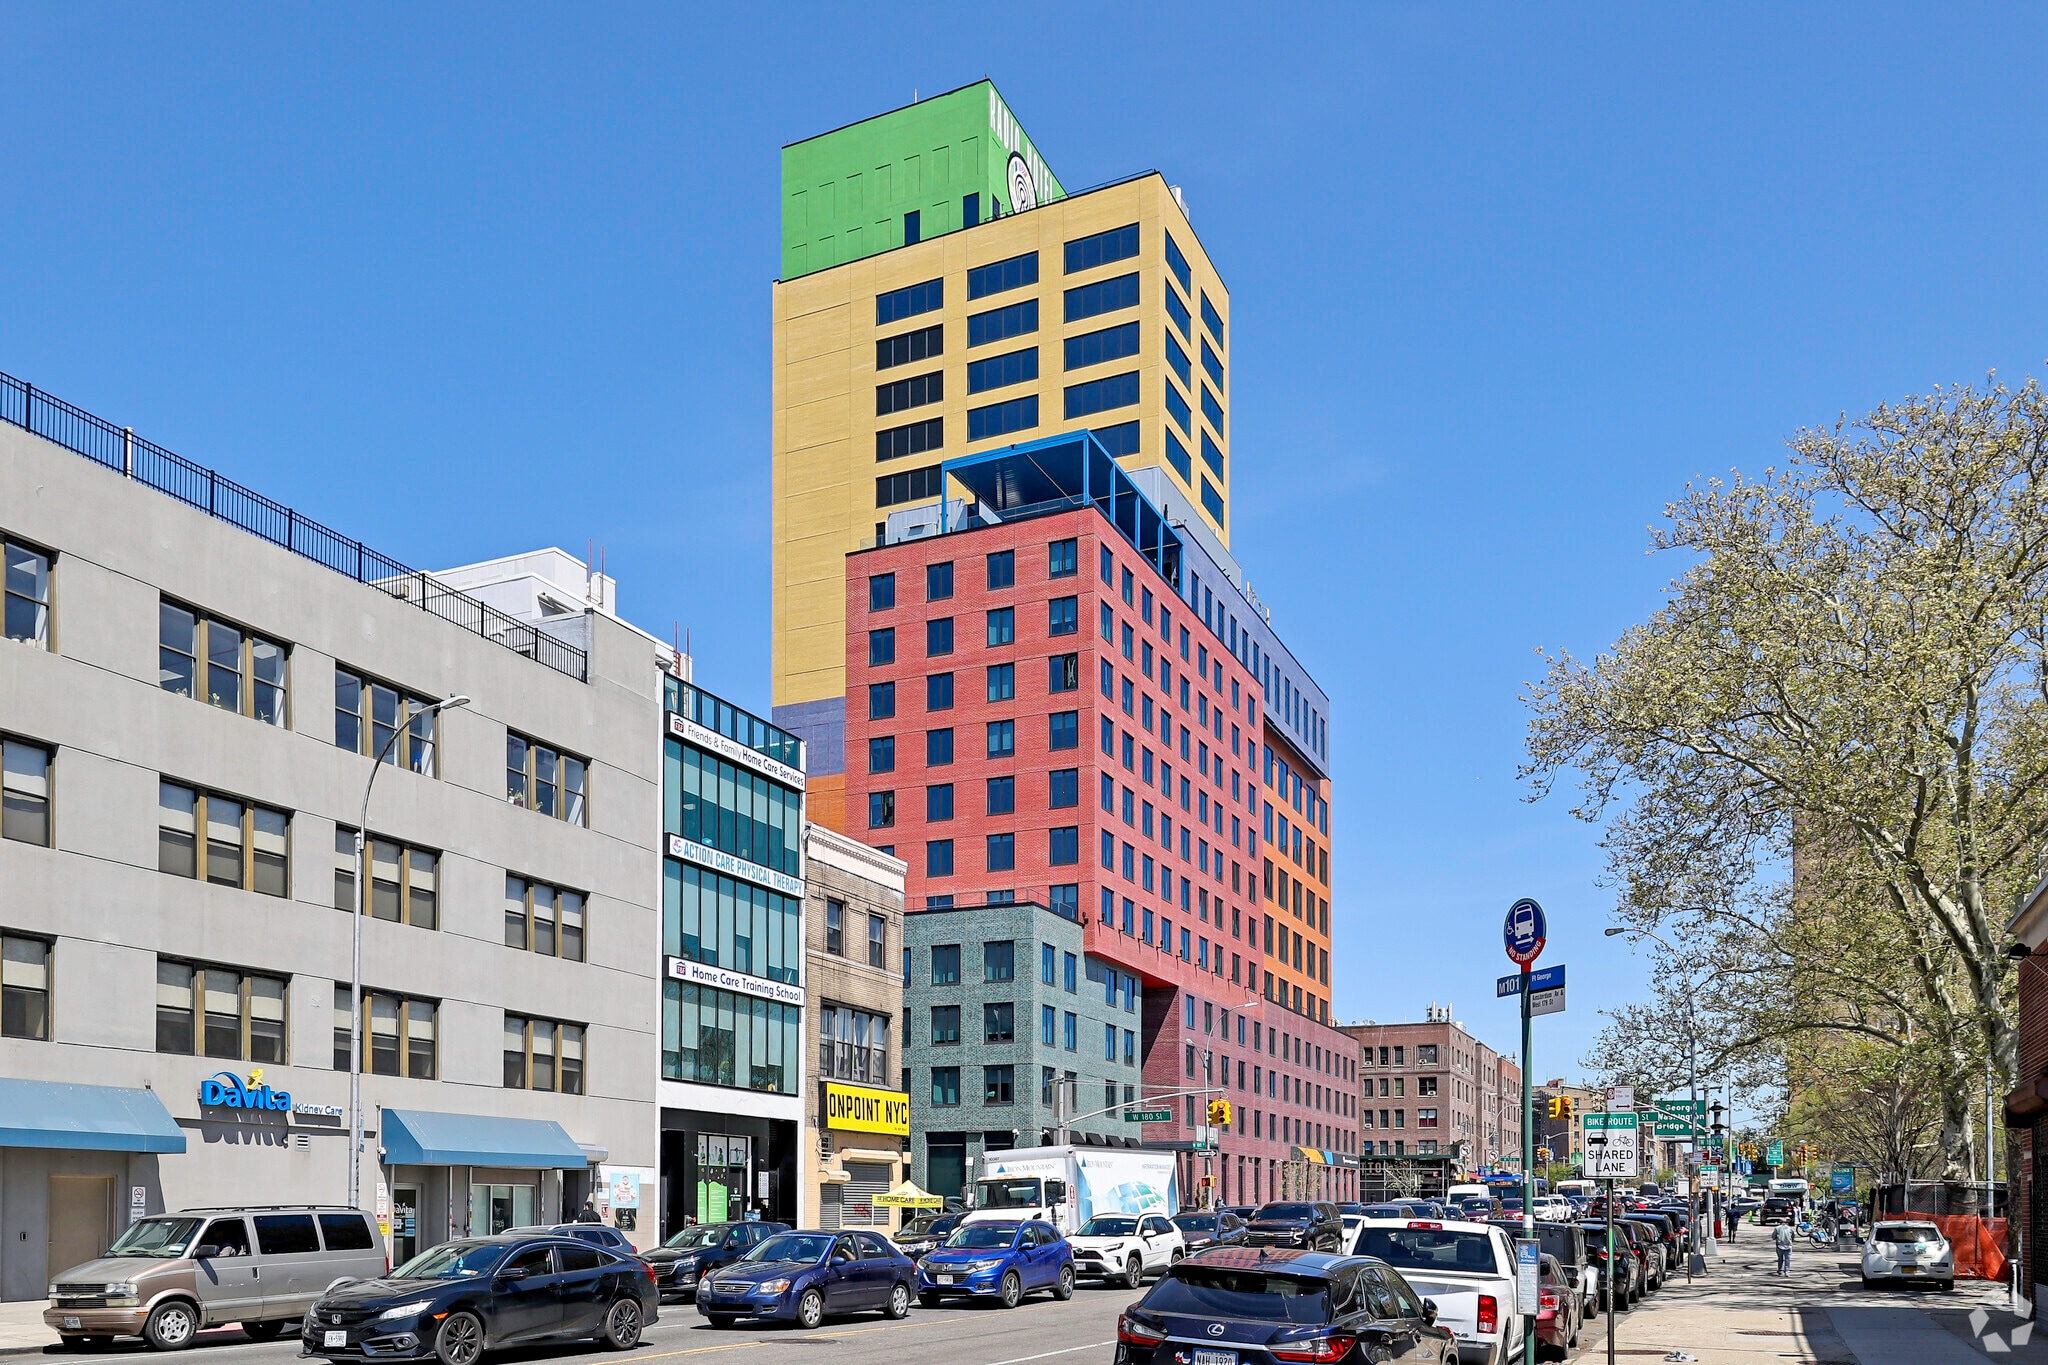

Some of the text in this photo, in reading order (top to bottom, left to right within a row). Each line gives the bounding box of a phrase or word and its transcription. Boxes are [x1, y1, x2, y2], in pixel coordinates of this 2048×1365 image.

[990, 88, 1053, 204] RADIO HOTEL
[687, 724, 804, 786] Friends & Family Home Care Services
[683, 842, 803, 895] ACTION CARE PHYSICAL THERAPY
[1508, 940, 1542, 961] NO STANDING
[1536, 972, 1552, 981] George
[692, 966, 801, 1001] Home Care Training School
[1498, 977, 1520, 995] M101
[201, 1071, 292, 1111] DaVita
[295, 1103, 343, 1115] Kidney Care
[829, 1093, 907, 1125] ONPOINT NYC
[1155, 1112, 1163, 1120] St
[1587, 1117, 1633, 1126] BIKE ROUTE
[1656, 1122, 1685, 1131] Bridge
[1588, 1150, 1634, 1160] SHARED
[1022, 1163, 1055, 1172] MOUNTAIN
[1596, 1162, 1626, 1172] LANE
[394, 1203, 413, 1214] aVita
